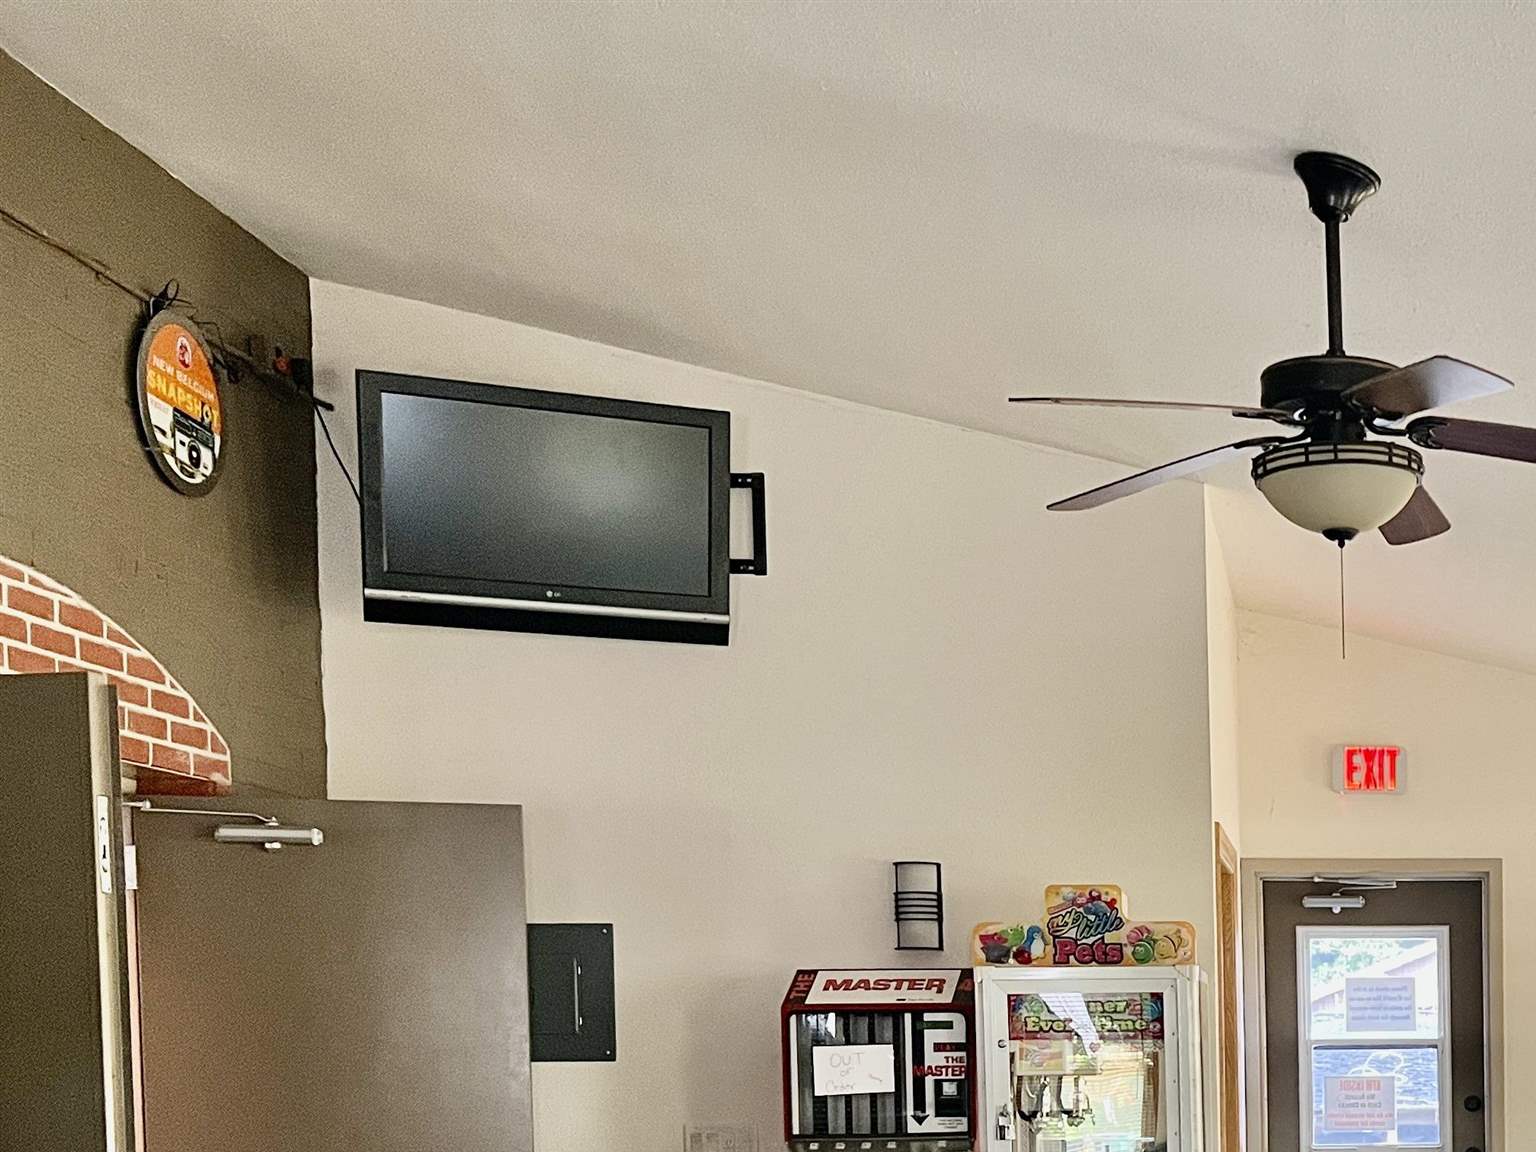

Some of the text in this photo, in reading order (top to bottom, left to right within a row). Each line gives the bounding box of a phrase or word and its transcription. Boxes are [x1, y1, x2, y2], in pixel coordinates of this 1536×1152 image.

[152, 354, 215, 401] NEW BELGIUM
[147, 367, 219, 428] SNAPSHOT
[1344, 746, 1399, 790] EXIT
[1075, 907, 1126, 940] little
[1053, 937, 1124, 965] Pets
[789, 973, 815, 999] THE
[821, 978, 947, 994] MASTER
[830, 1051, 865, 1069] OUT
